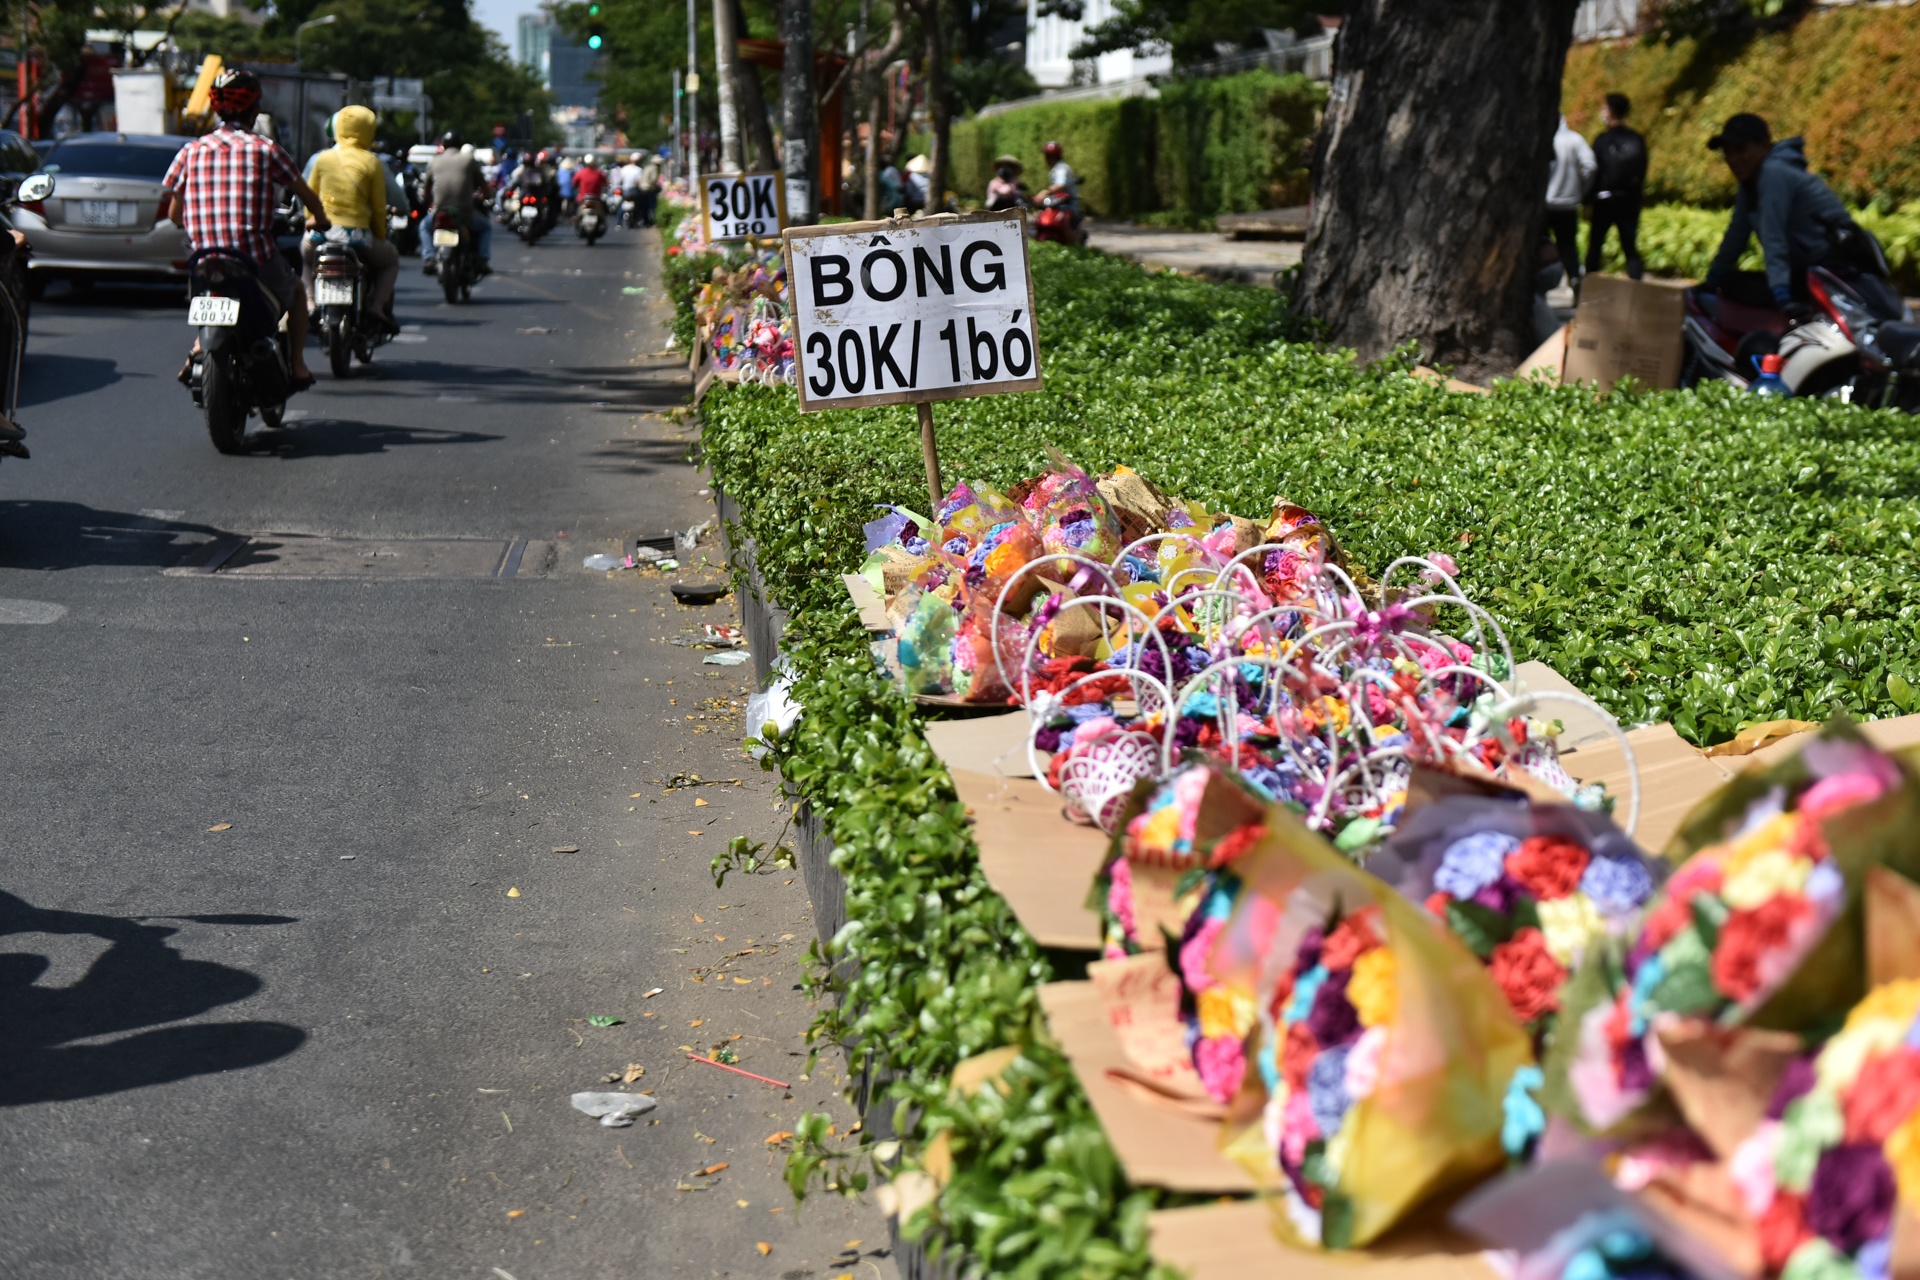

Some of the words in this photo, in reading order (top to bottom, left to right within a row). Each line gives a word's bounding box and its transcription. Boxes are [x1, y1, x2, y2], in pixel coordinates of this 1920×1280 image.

[708, 177, 777, 222] 30K
[809, 235, 1007, 307] BÔNG
[939, 309, 1032, 383] 1bó
